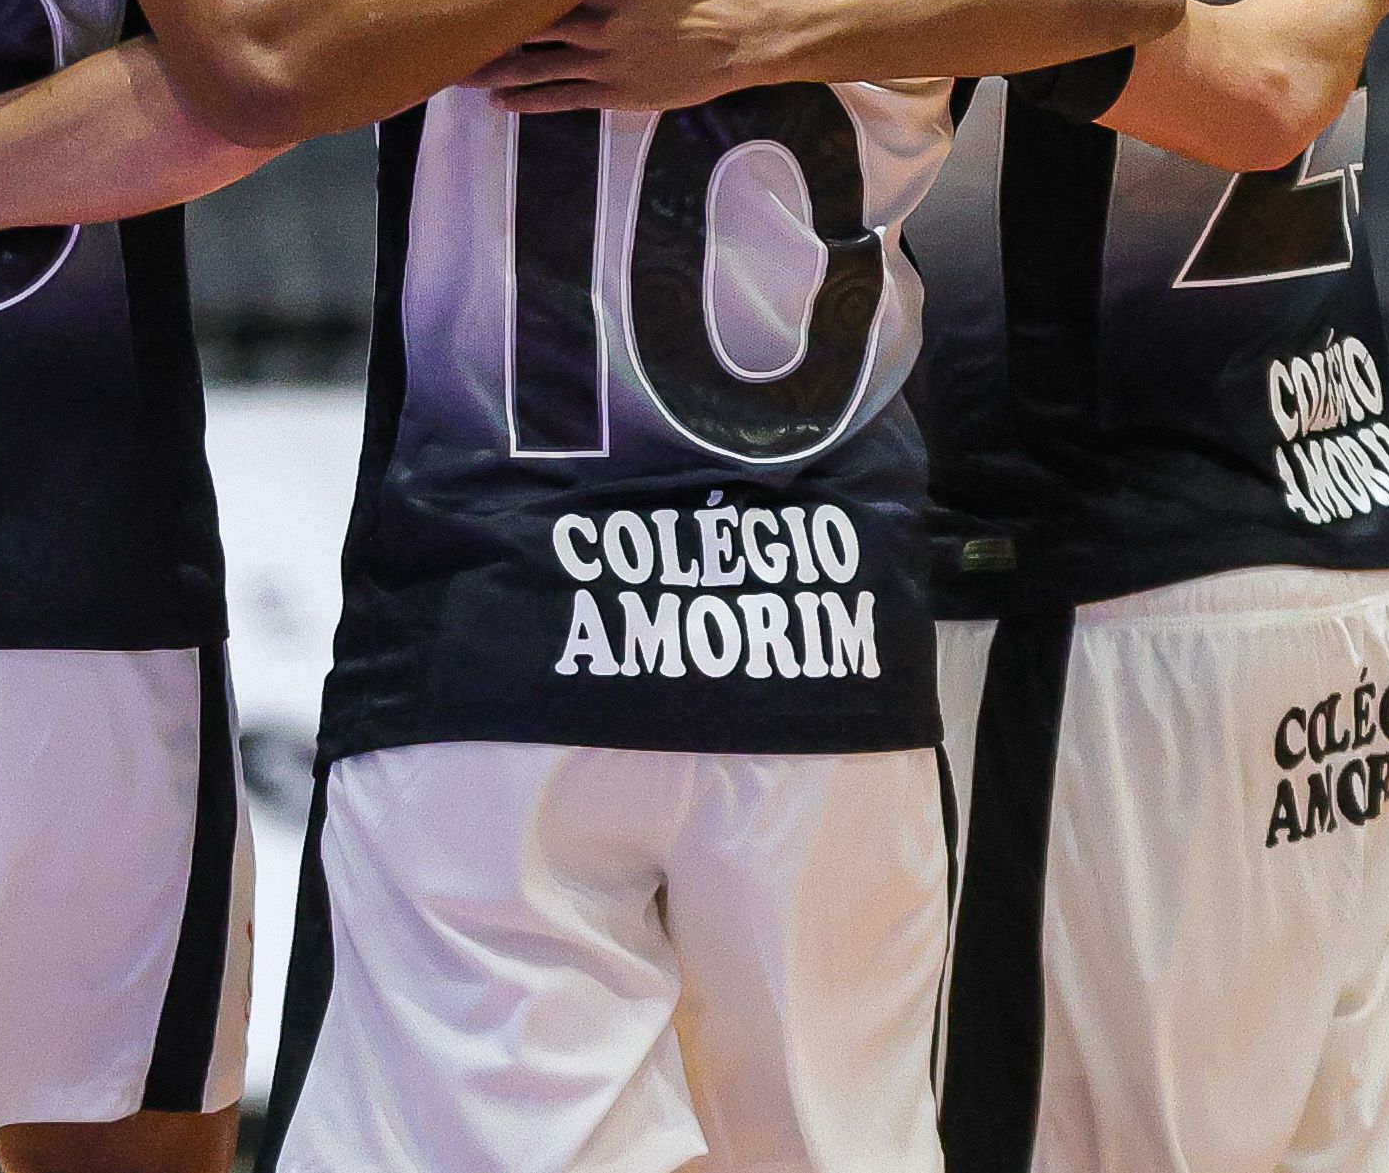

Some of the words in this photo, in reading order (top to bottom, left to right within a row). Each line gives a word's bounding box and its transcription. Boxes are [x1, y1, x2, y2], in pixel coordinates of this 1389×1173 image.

[504, 80, 887, 464] 10
[553, 490, 859, 587] COLÉGIO
[555, 589, 881, 678] AMORIM
